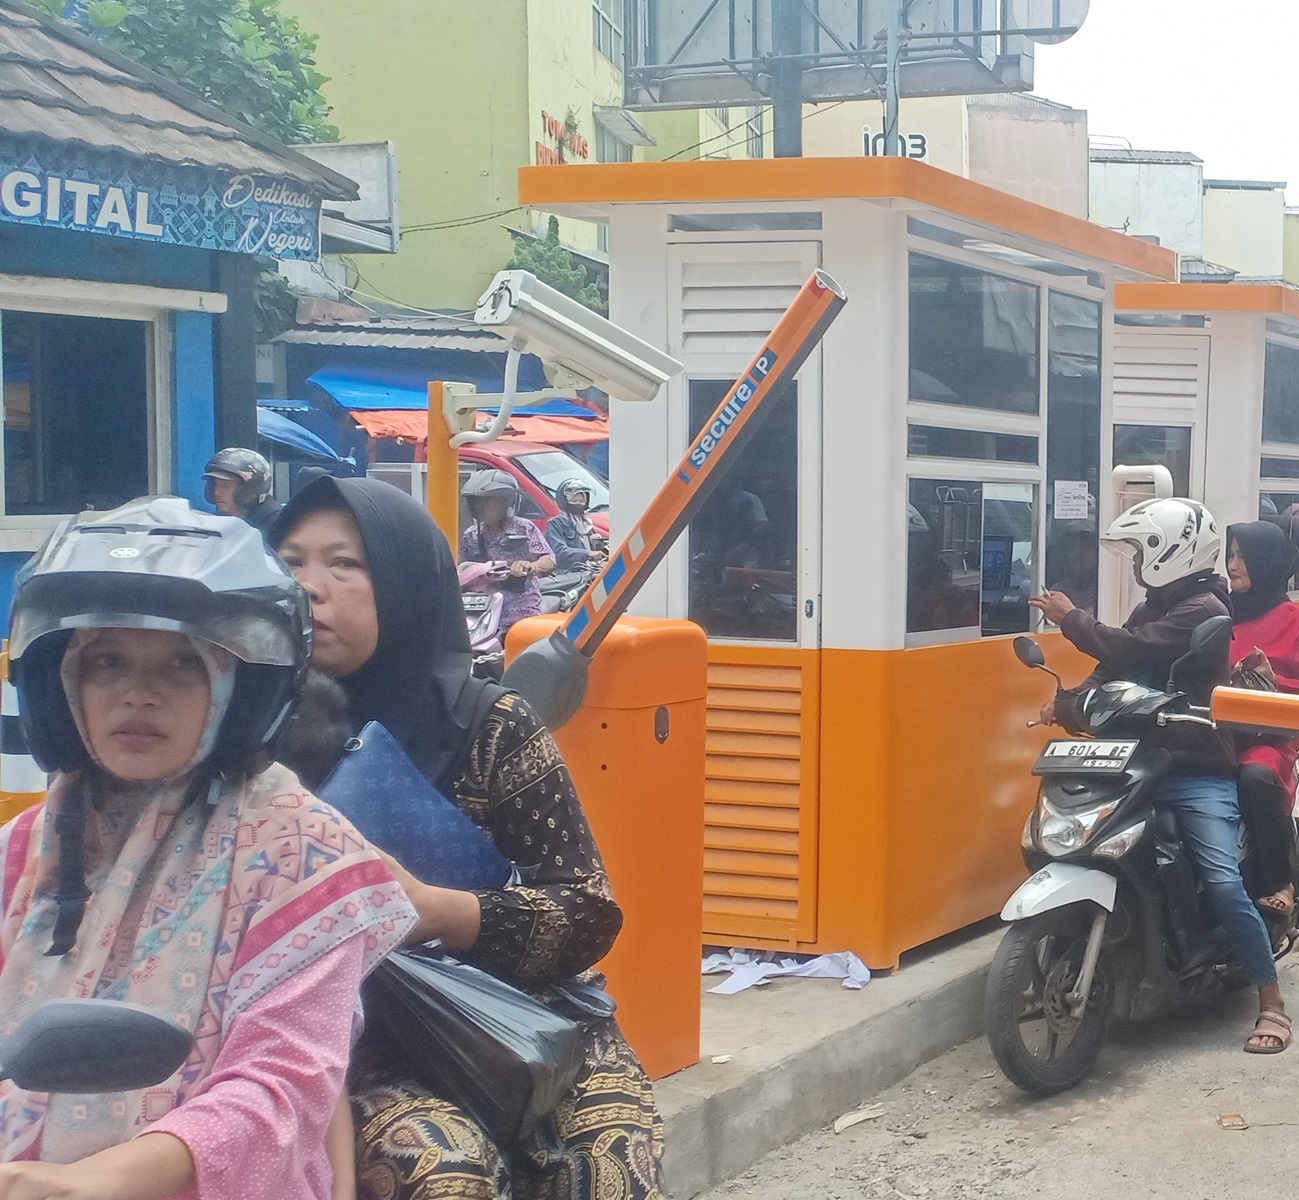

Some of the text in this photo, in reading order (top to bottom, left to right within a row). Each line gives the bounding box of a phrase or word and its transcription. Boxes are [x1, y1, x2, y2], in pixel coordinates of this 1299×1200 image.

[222, 174, 314, 209] Dedikasi
[237, 211, 313, 253] Negeri
[691, 356, 769, 466] secure P
[1048, 745, 1057, 757] A
[1067, 745, 1101, 757] 6014
